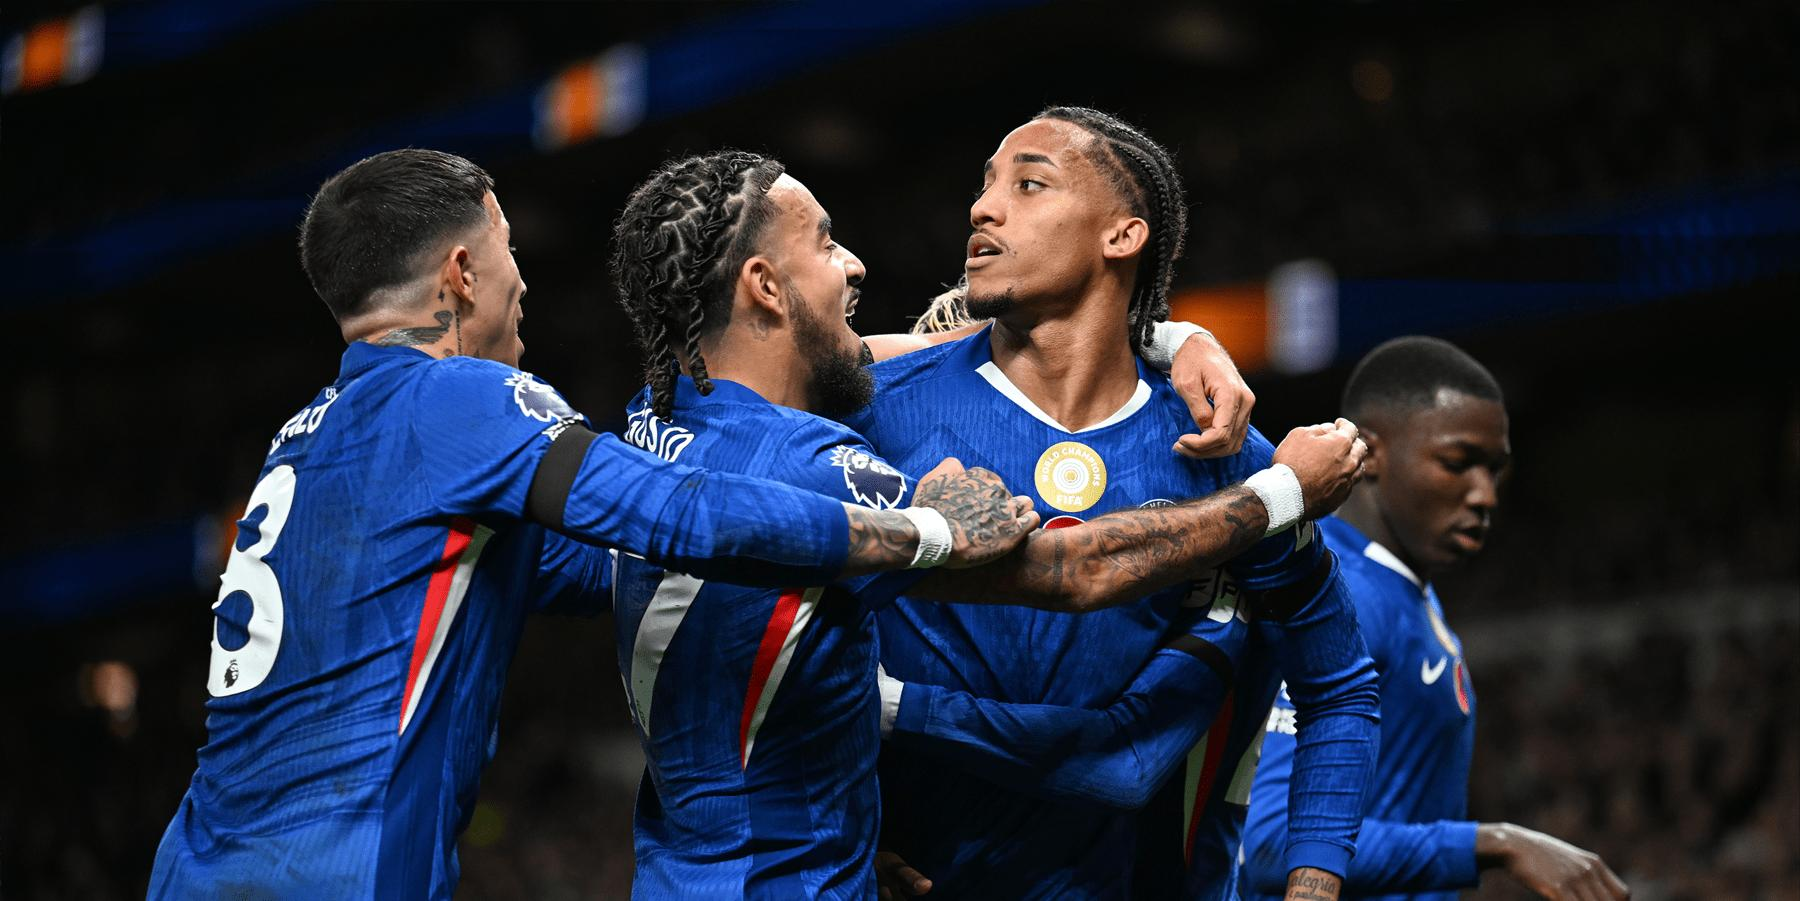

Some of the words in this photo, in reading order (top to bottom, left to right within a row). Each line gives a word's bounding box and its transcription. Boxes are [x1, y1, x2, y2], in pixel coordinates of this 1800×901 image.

[1041, 450, 1060, 483] WORLD
[1061, 447, 1101, 487] CHAMPIONS
[1056, 495, 1084, 506] FIFA
[207, 465, 297, 697] 8
